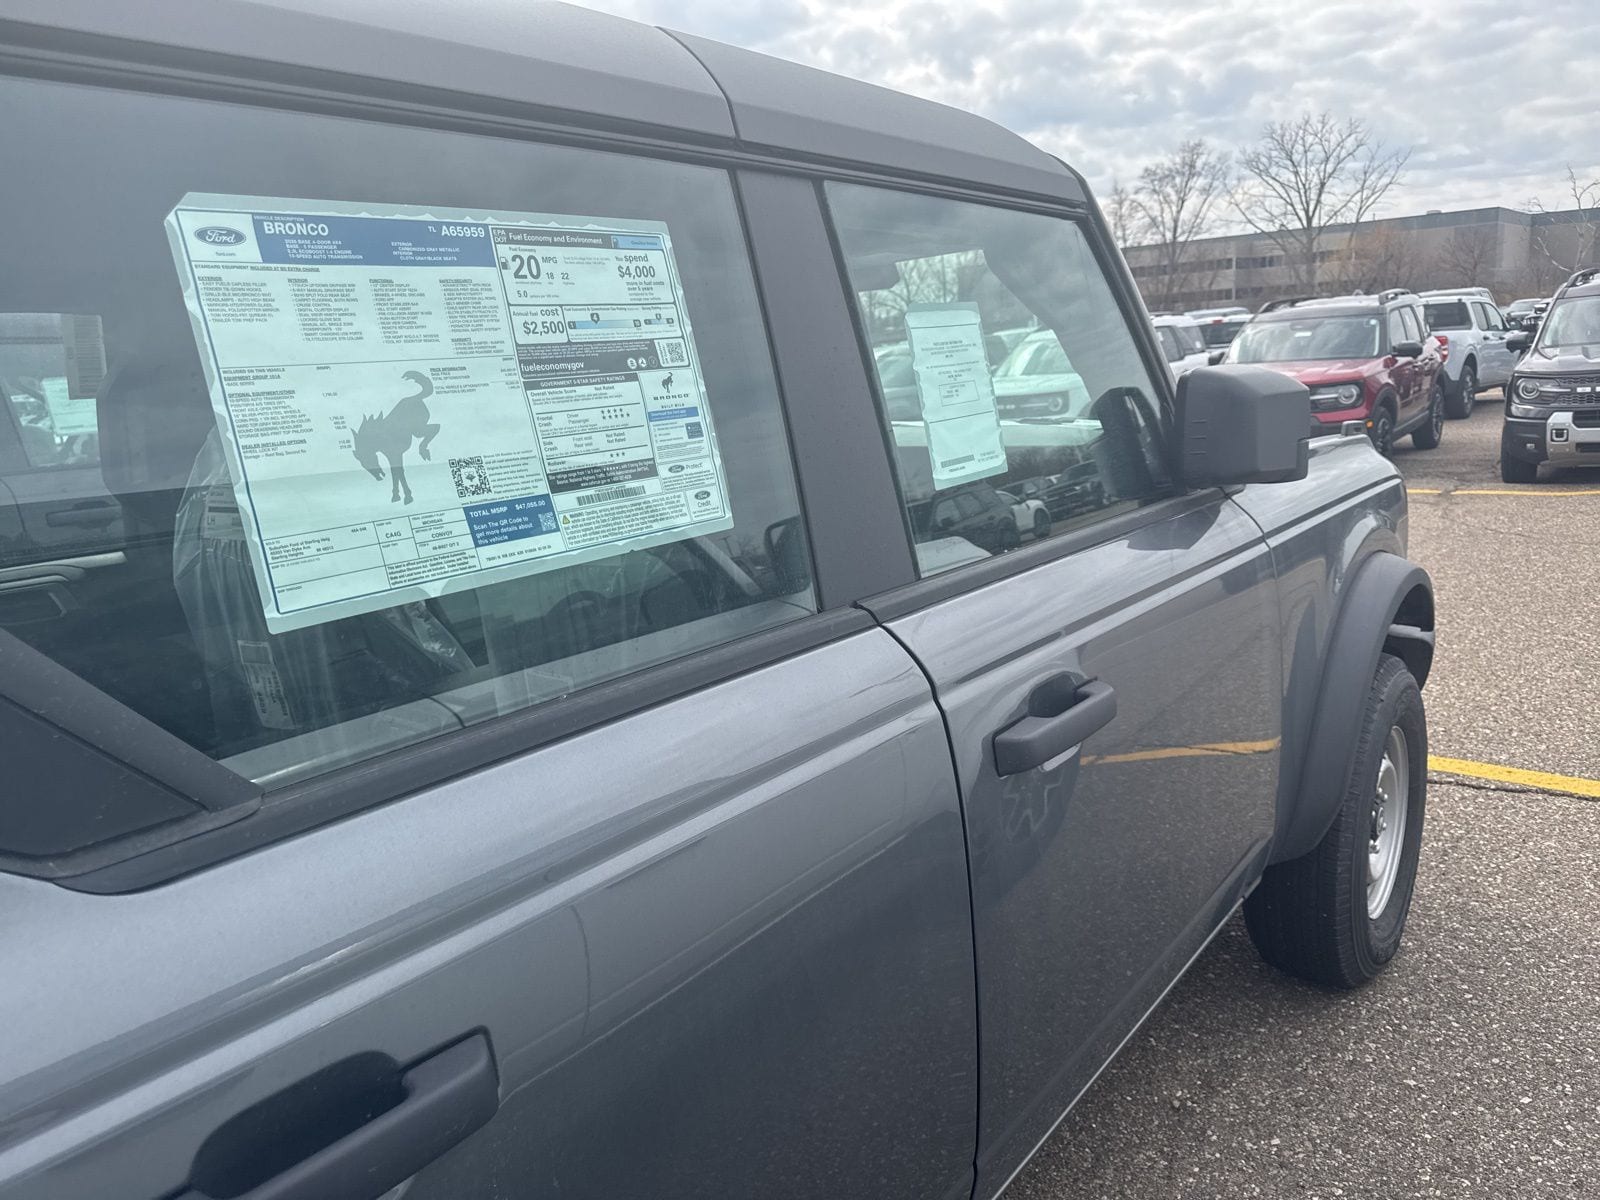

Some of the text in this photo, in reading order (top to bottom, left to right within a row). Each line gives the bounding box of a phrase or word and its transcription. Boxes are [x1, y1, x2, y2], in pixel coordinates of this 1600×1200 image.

[263, 221, 329, 236] BRONCO
[441, 225, 485, 238] A65959
[493, 229, 506, 237] EPA
[508, 233, 523, 241] Fuel
[524, 234, 553, 243] Economy
[567, 236, 602, 244] Environment
[624, 254, 648, 264] spend
[511, 254, 541, 280] 20
[617, 265, 655, 280] $4,000
[546, 272, 570, 280] 18 22
[517, 290, 528, 298] 5.0
[540, 308, 560, 317] cost
[523, 321, 565, 336] $2,500
[469, 509, 490, 518] TOTAL
[491, 506, 508, 514] MSRP
